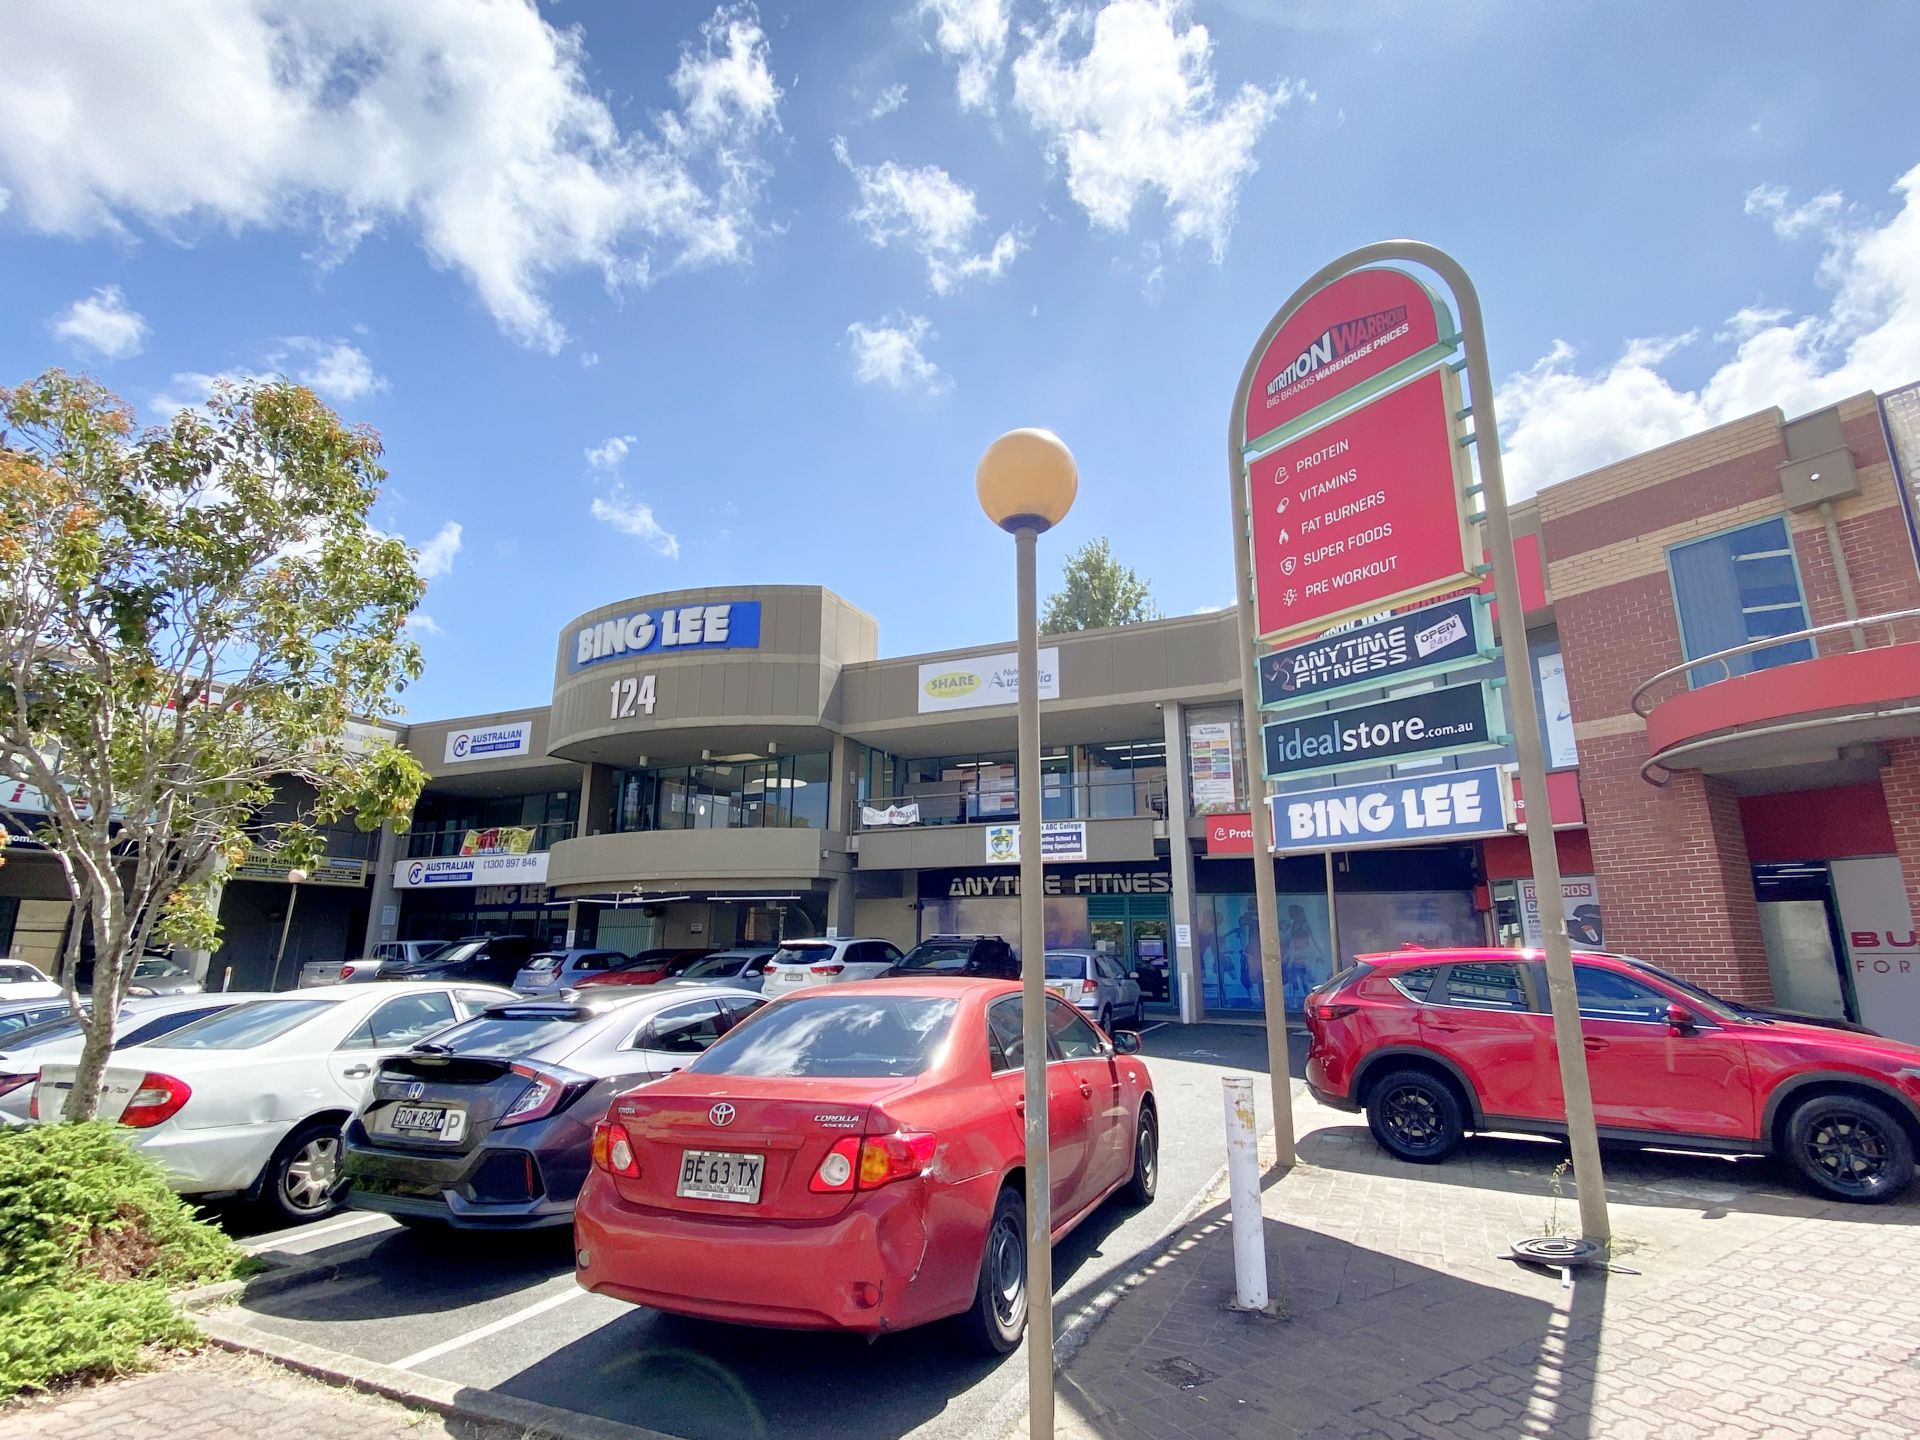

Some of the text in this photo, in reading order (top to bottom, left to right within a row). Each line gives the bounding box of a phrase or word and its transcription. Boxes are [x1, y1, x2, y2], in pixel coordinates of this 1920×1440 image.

[1266, 323, 1409, 408] BIG BRANDS WAREHOUSE PRICES
[1267, 330, 1333, 396] NUTRITION
[1296, 438, 1349, 473] PROTEIN
[1299, 468, 1357, 502] VITAMINS
[1301, 490, 1386, 535] FAT BURNERS
[1303, 522, 1393, 566] SUPER FOODS
[1305, 556, 1397, 598] PRE WORKOUT
[577, 604, 731, 664] BING LEE
[1293, 625, 1406, 673] ANYTIME
[1420, 619, 1457, 643] OPEN
[931, 675, 975, 690] SHARE
[1296, 646, 1408, 688] FITNESS
[610, 674, 657, 719] 124
[471, 729, 522, 744] AUSTRALIAN
[1277, 715, 1474, 763] idealstore.com.au
[1287, 779, 1483, 840] BING LEE
[425, 860, 475, 872] AUSTRALIAN
[505, 858, 520, 868] 897
[522, 857, 537, 867] 846
[949, 872, 1173, 896] ANYTIE FITNES
[475, 884, 548, 906] BING LEE
[445, 1113, 461, 1137] P
[709, 1161, 730, 1184] 63
[738, 1162, 759, 1187] TX
